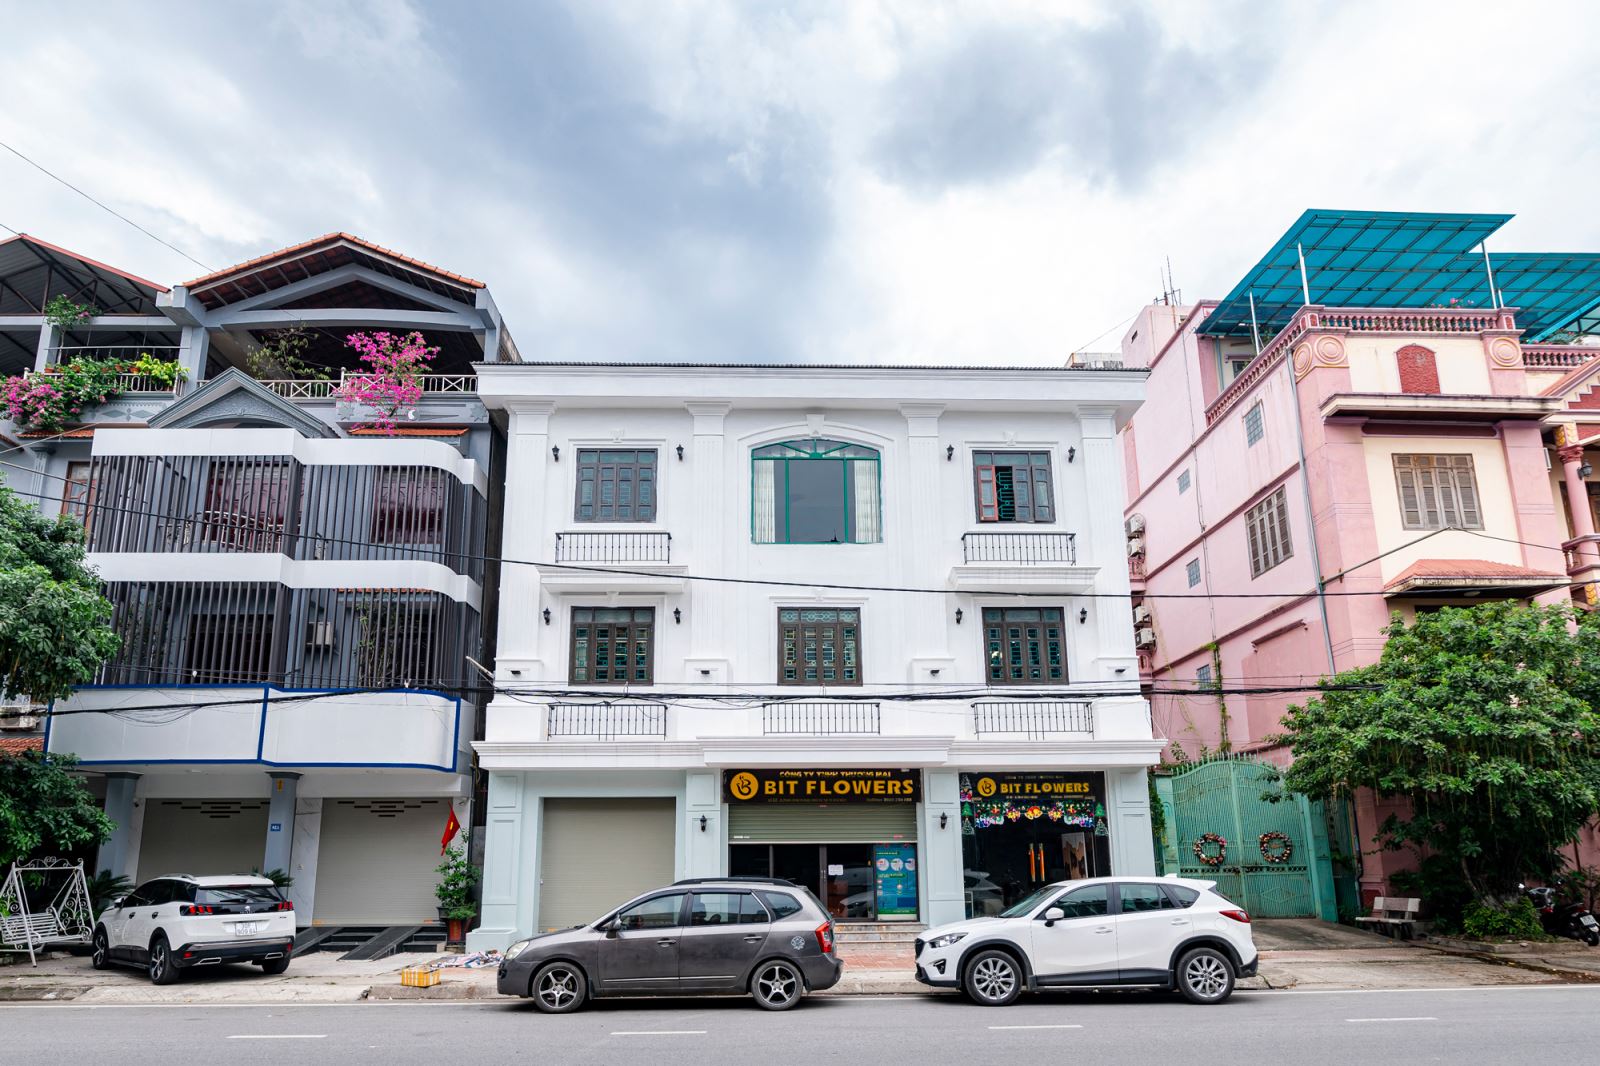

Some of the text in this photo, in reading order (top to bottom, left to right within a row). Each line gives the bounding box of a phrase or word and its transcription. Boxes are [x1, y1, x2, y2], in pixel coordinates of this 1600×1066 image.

[764, 780, 913, 795] BIT FLOWERS
[999, 782, 1089, 793] BIT FLOWERS
